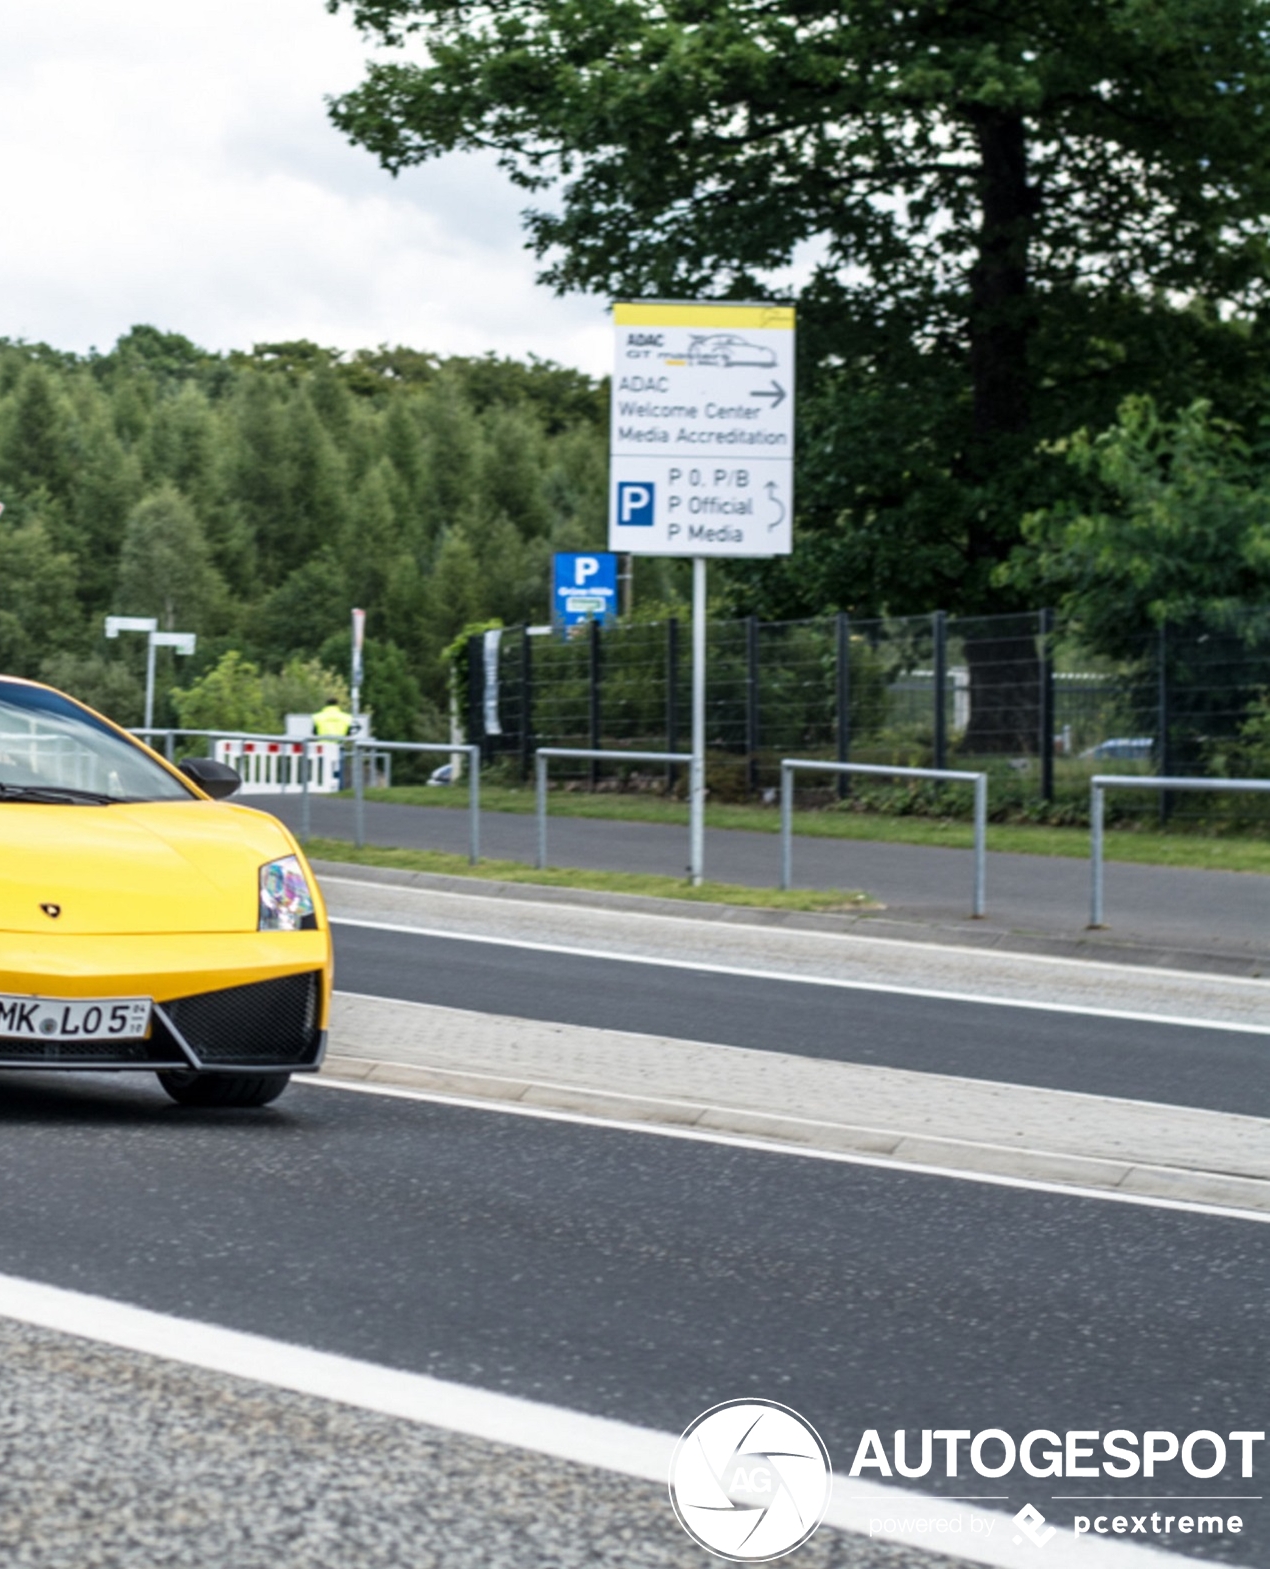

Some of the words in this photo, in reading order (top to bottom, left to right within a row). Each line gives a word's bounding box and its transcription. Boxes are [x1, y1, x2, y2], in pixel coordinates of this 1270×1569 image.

[626, 333, 664, 347] ADAC
[619, 376, 668, 393] ADAC
[619, 402, 697, 418] Welcome
[704, 403, 760, 420] Center
[618, 427, 669, 443] Media
[675, 428, 787, 445] Accreditation
[668, 468, 682, 486] P
[713, 469, 750, 488] P/B
[621, 486, 650, 522] P
[668, 496, 682, 513] P
[688, 496, 753, 515] Official
[668, 524, 681, 541] P
[688, 524, 743, 543] Media
[575, 557, 600, 586] P
[108, 1005, 130, 1033] 5
